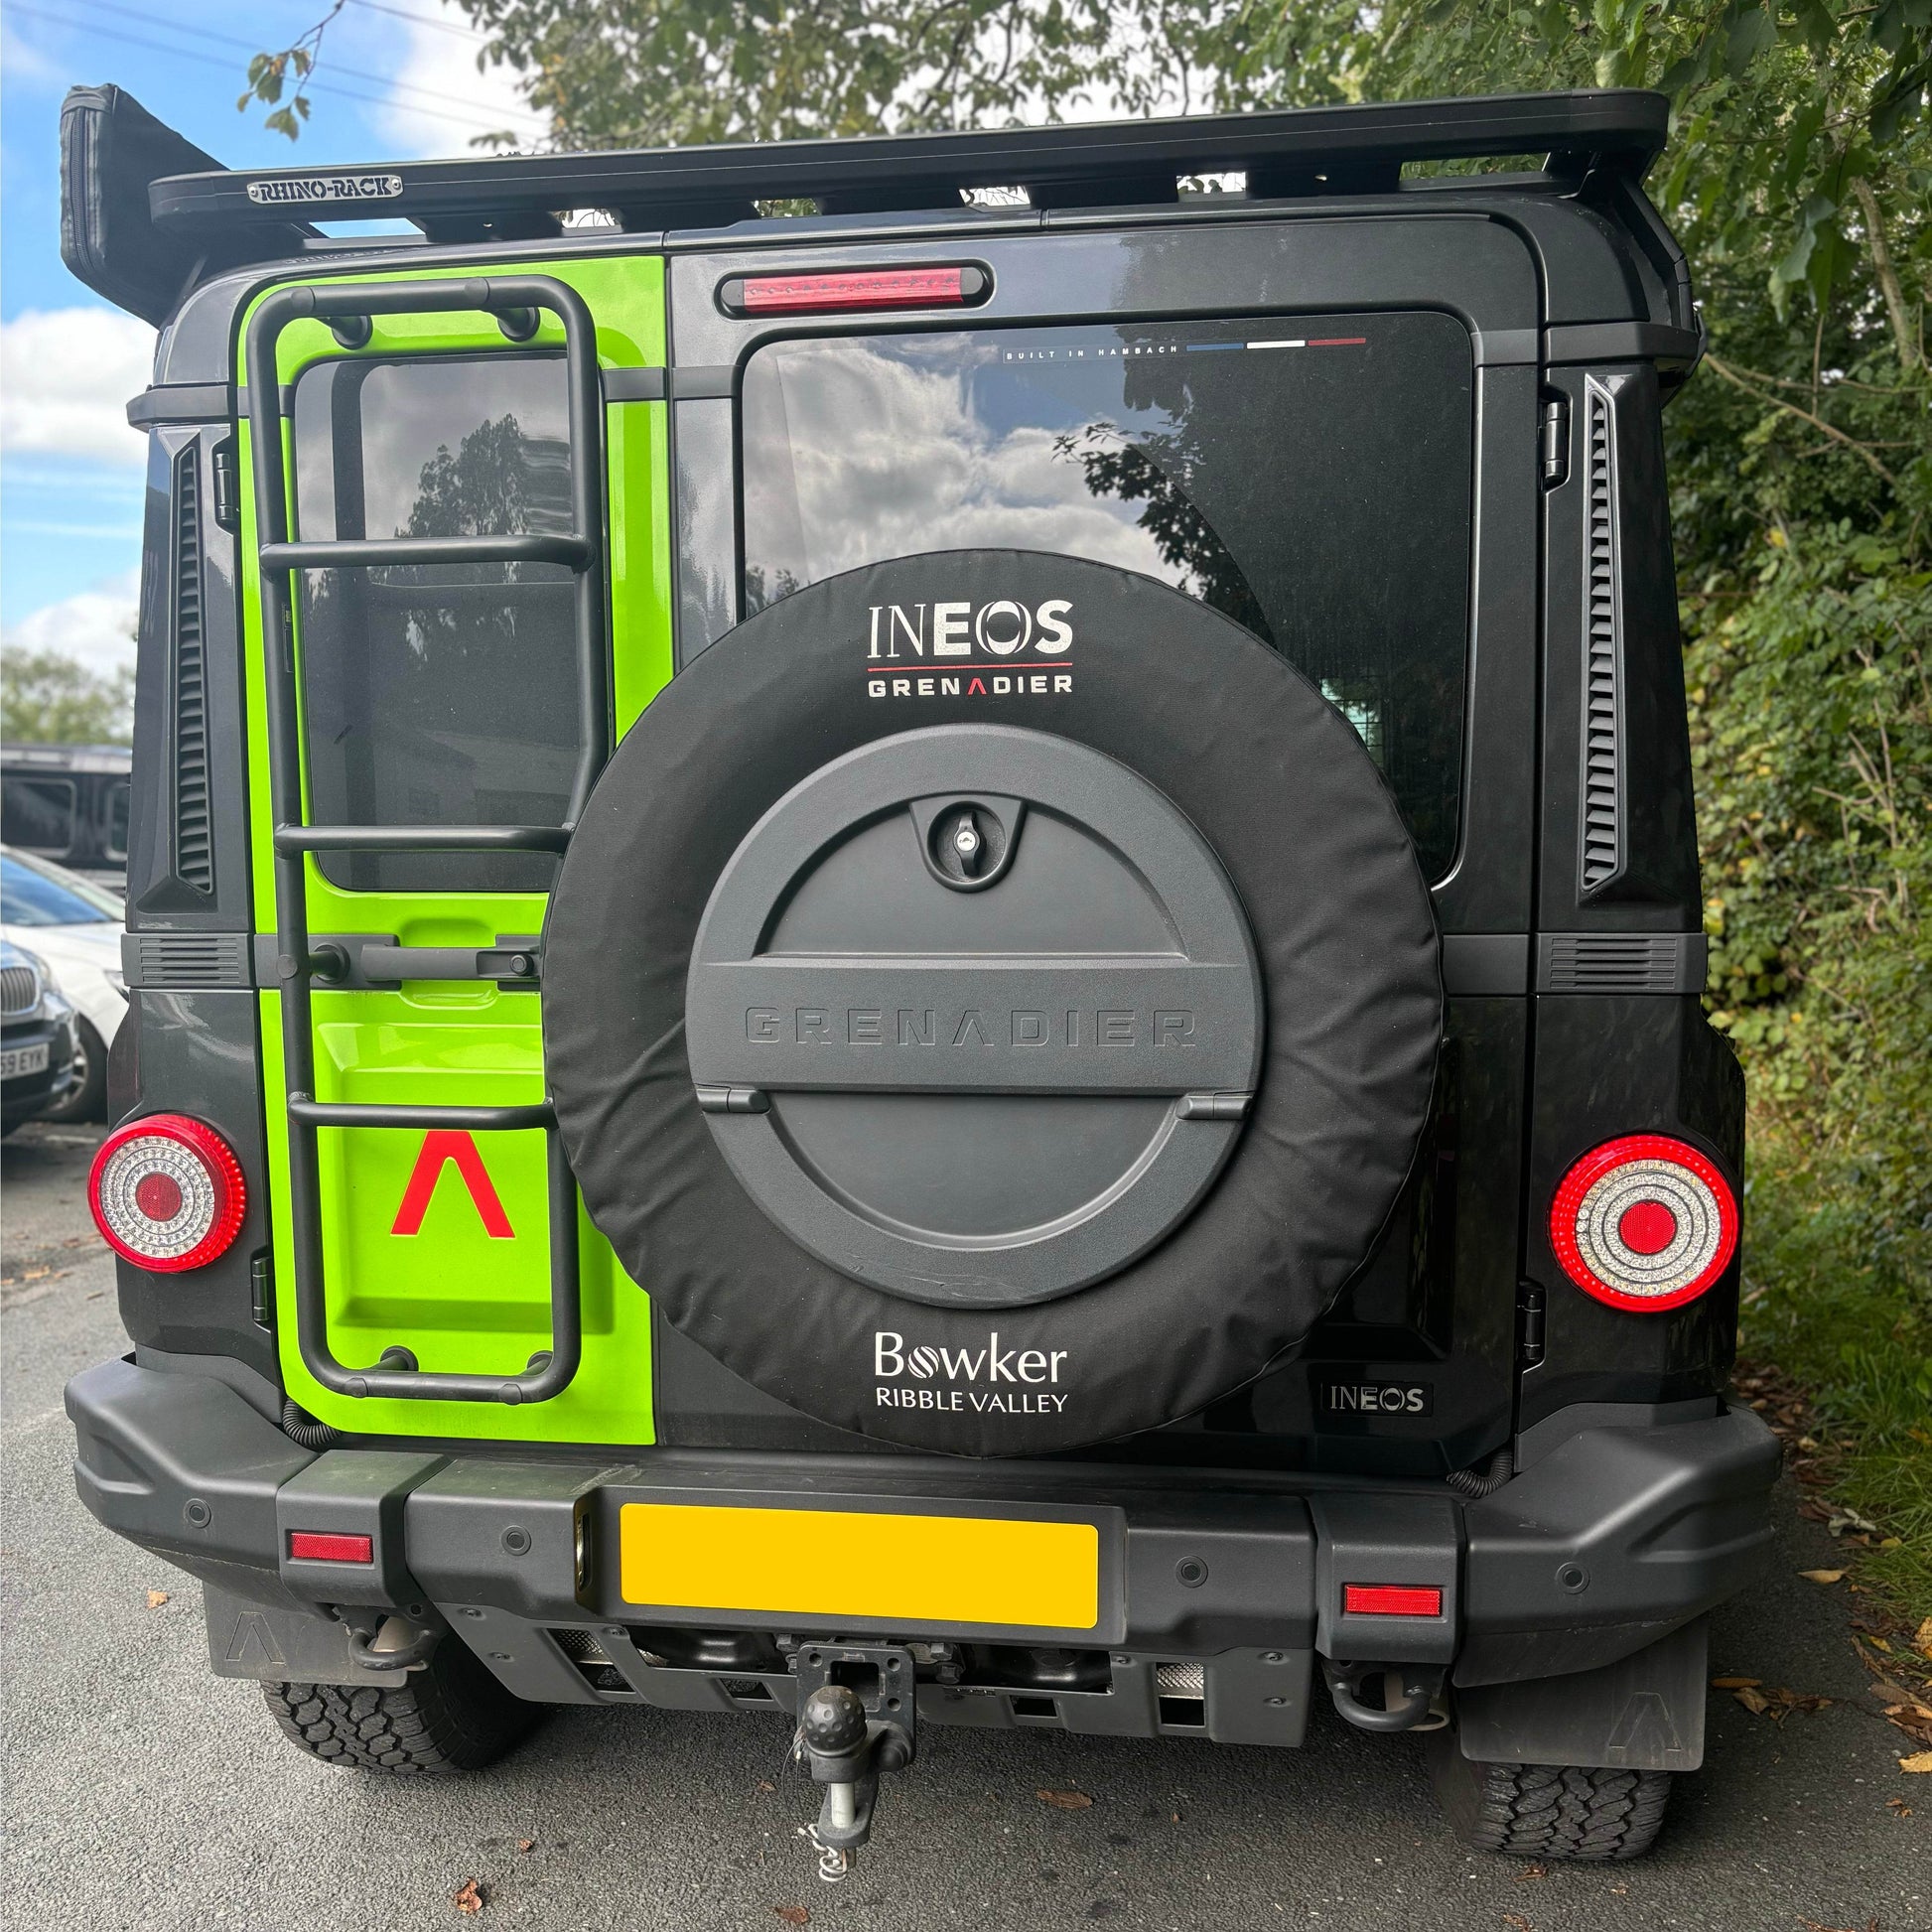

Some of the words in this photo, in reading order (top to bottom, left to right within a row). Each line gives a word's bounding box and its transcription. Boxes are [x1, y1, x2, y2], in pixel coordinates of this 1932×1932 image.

[258, 177, 392, 202] RHINO-RACK
[1007, 350, 1055, 360] BUILT
[1068, 349, 1083, 358] IN
[1098, 345, 1177, 357] HAMBACH
[868, 599, 1074, 659] INEOS
[868, 674, 1073, 698] GRENADIER
[746, 1007, 1197, 1047] GRENADIER
[875, 1331, 1067, 1383] Bowker
[876, 1387, 964, 1412] RIBBLE
[968, 1392, 1068, 1414] VALLEY
[1330, 1386, 1424, 1412] INEOS
